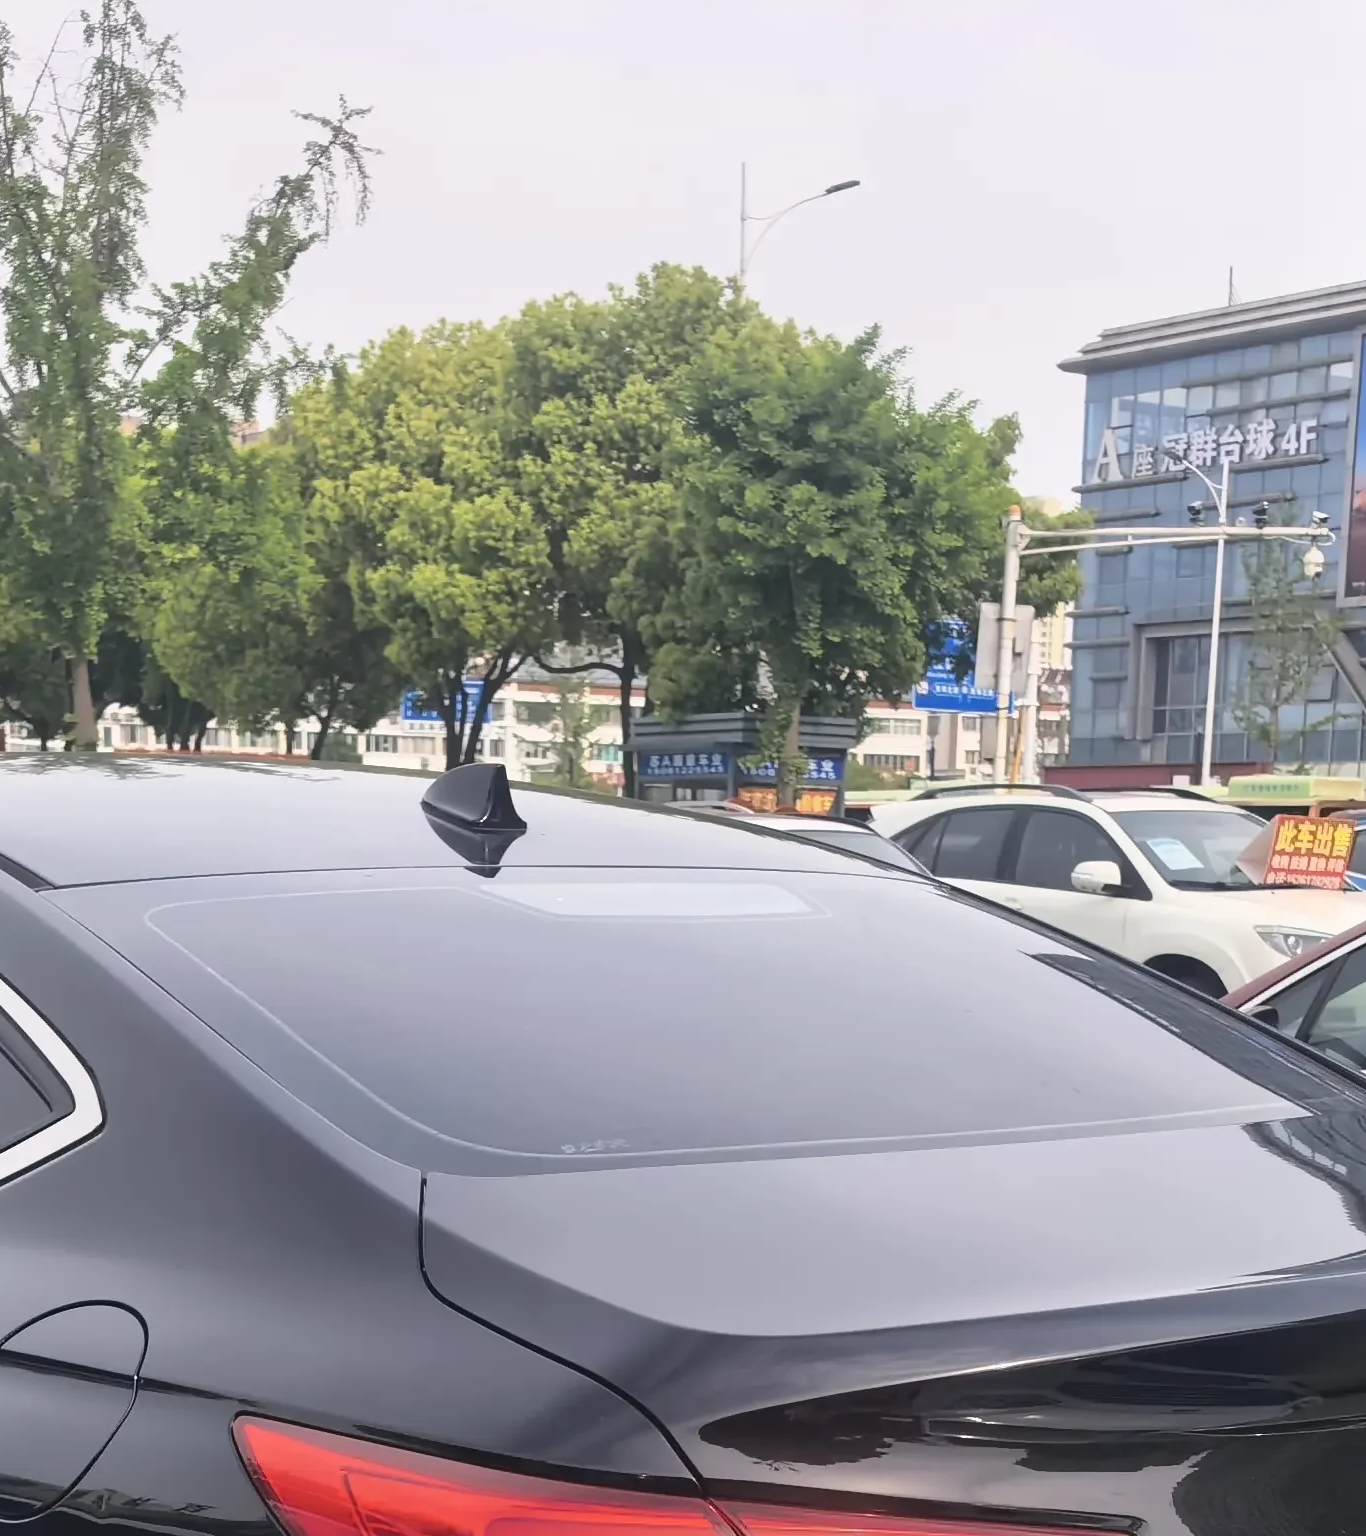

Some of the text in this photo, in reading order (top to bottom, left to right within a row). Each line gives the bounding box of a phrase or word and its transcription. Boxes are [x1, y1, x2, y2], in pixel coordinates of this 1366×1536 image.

[1280, 419, 1319, 456] 4F
[1274, 819, 1353, 858] 此车出售
